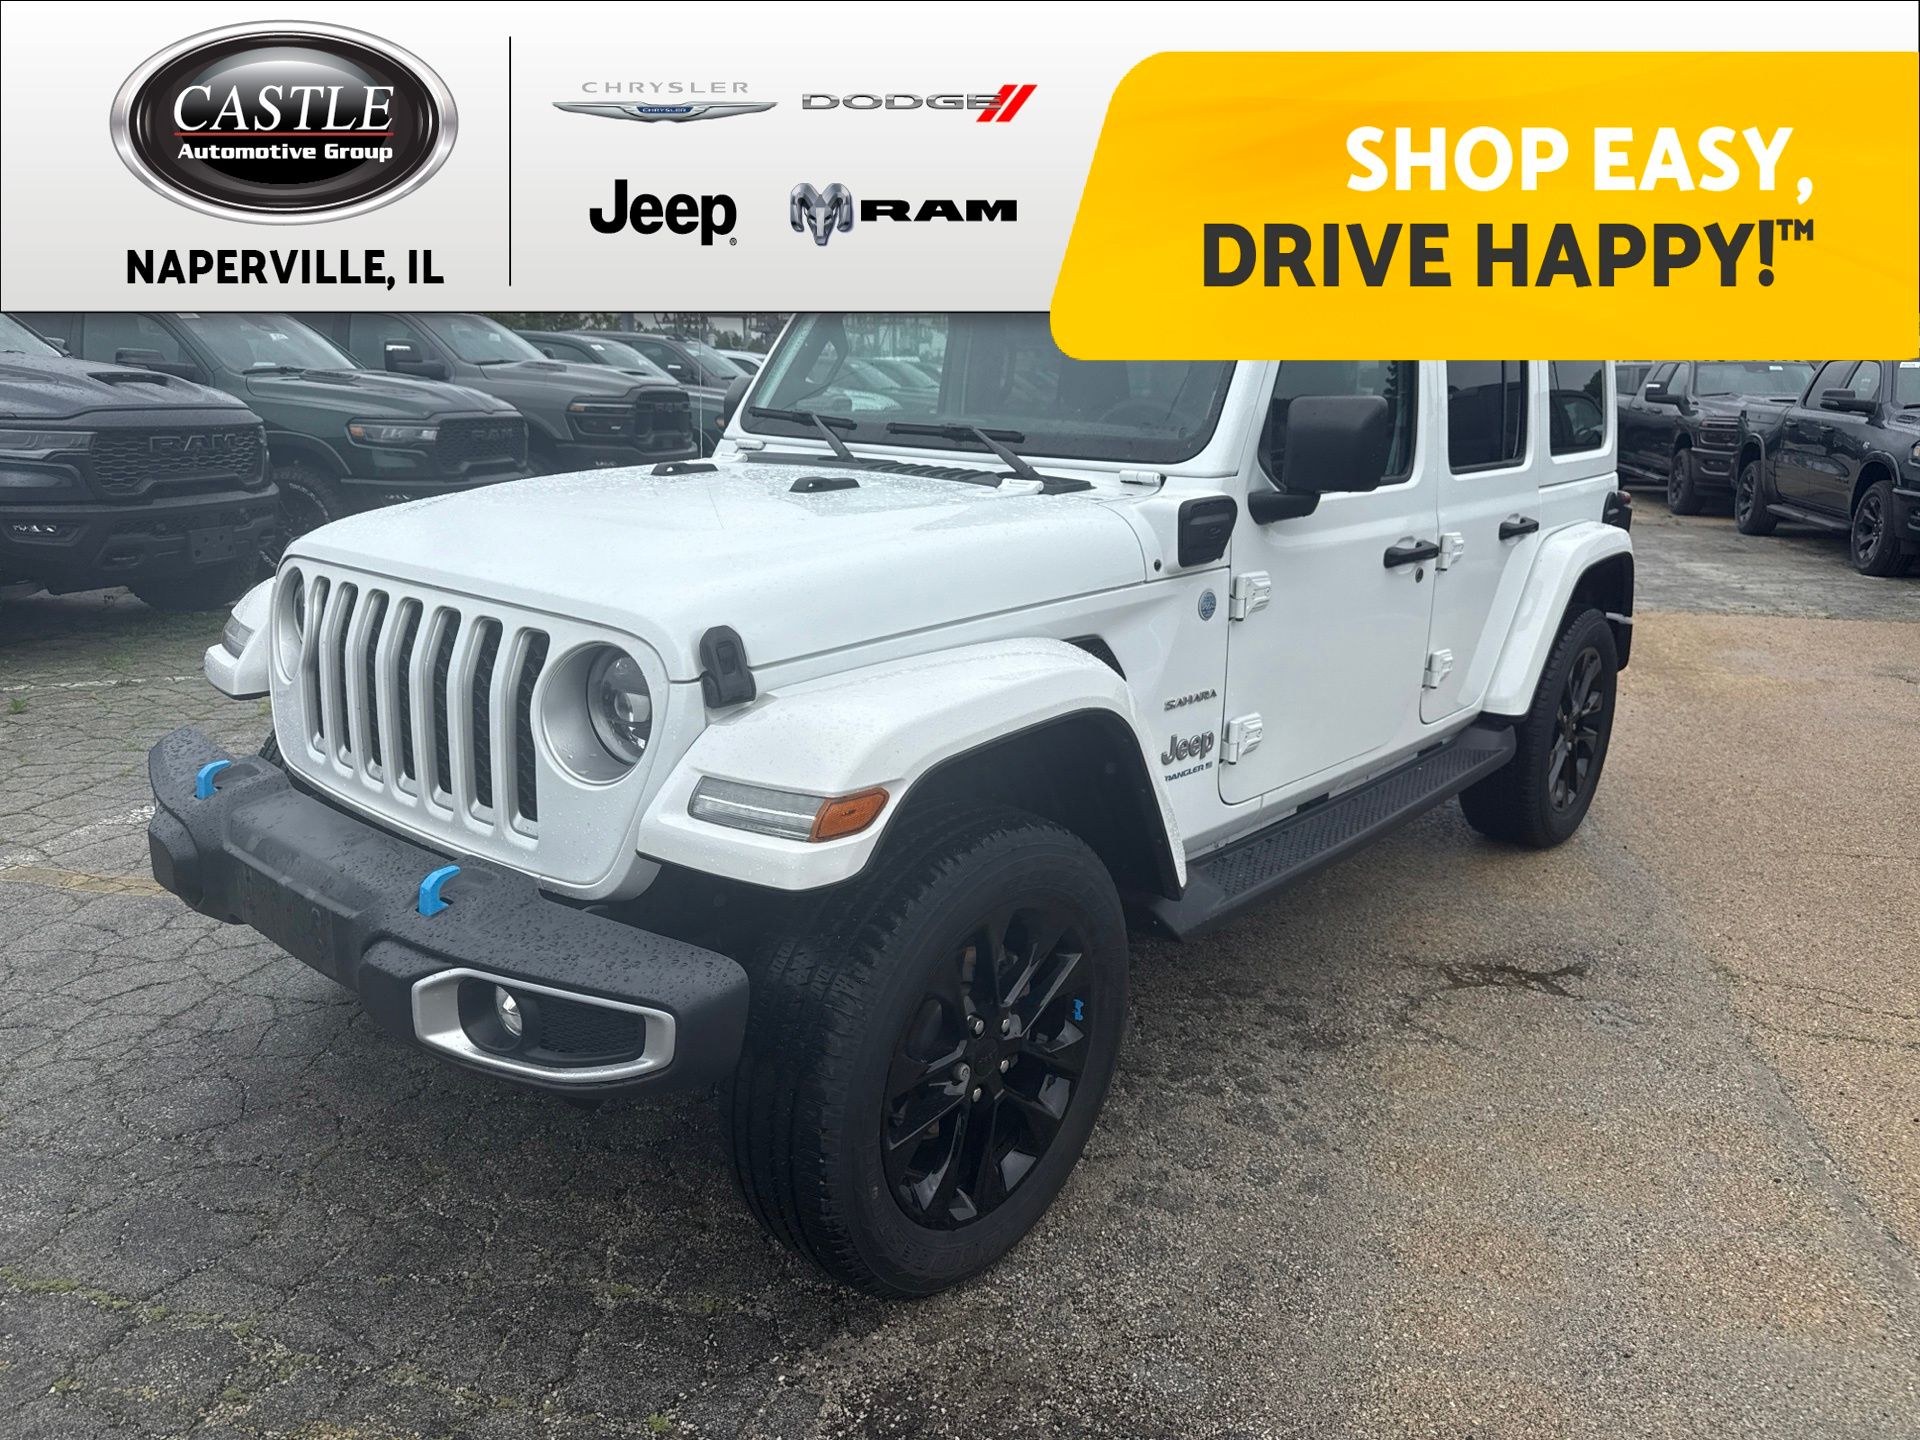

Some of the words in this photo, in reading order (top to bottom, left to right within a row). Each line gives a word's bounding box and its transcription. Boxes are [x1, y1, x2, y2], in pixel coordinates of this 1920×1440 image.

[149, 433, 237, 452] RAM
[1164, 689, 1217, 711] SAHARA
[1161, 731, 1214, 766] Jeep
